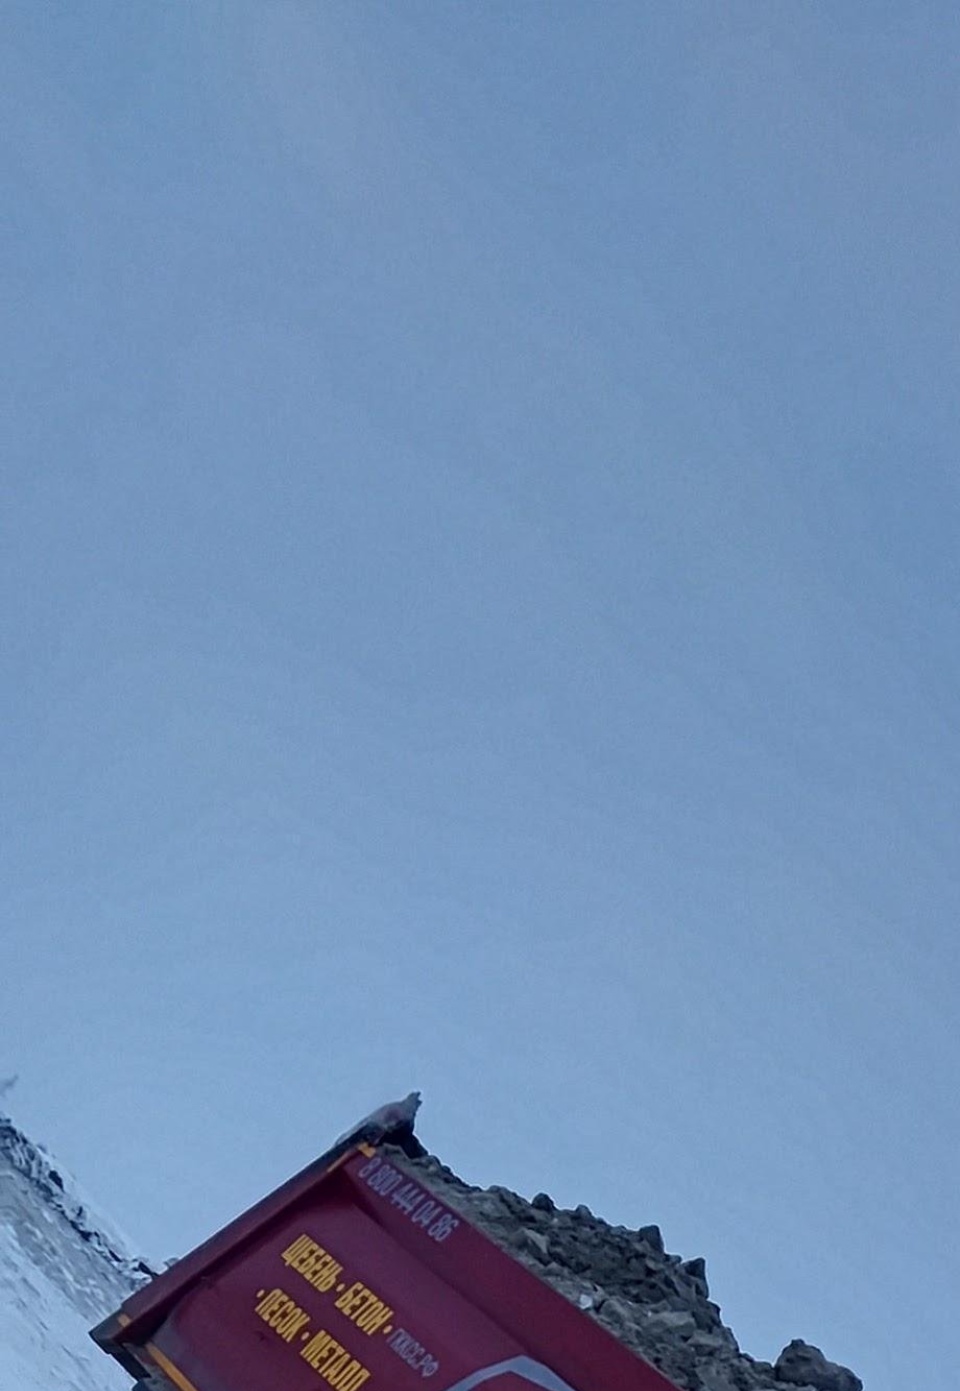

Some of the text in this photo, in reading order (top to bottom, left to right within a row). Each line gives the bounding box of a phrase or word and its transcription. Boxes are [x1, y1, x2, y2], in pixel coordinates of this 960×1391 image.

[358, 1157, 459, 1242] 8 800 444 04 86
[254, 1288, 311, 1343] ПЕСОК
[281, 1233, 344, 1293] ЩЕБЕНЬ
[334, 1281, 394, 1336] БЕТОН
